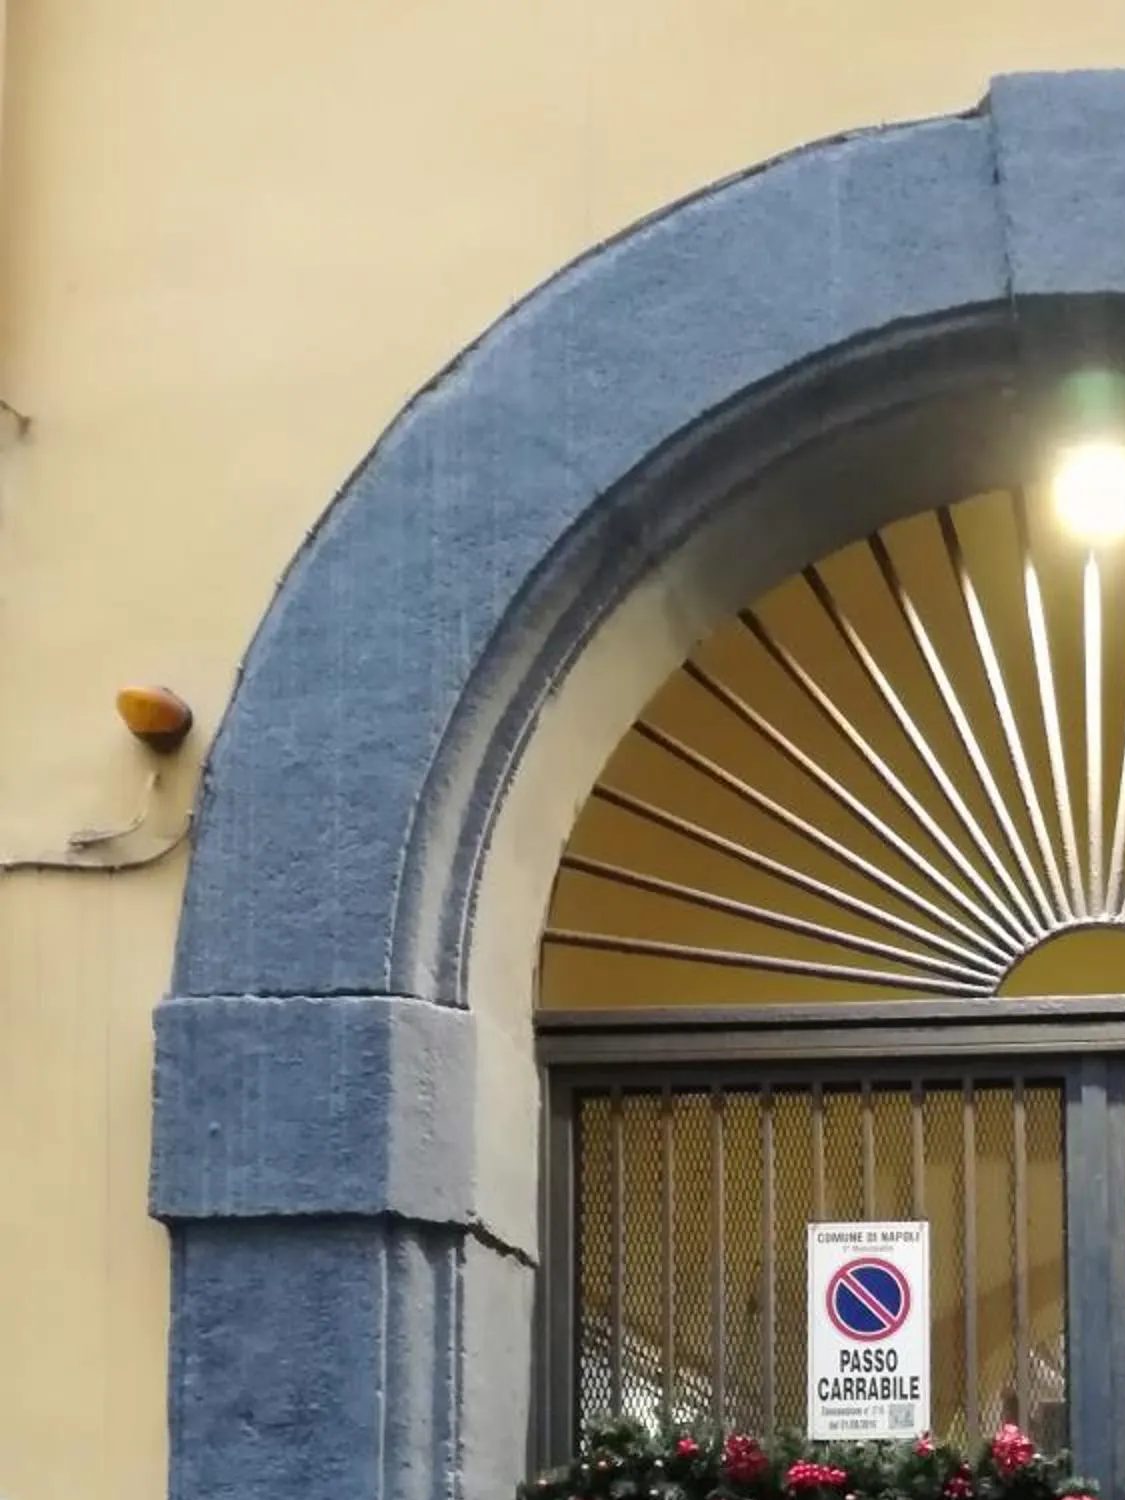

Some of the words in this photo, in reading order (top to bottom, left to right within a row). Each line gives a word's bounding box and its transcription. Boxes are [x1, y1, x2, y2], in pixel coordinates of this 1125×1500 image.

[818, 1231, 863, 1243] COMUNE
[866, 1231, 877, 1242] DI
[881, 1231, 920, 1243] NAPOLI
[840, 1349, 898, 1373] PASSO
[818, 1376, 920, 1401] CARRABILE
